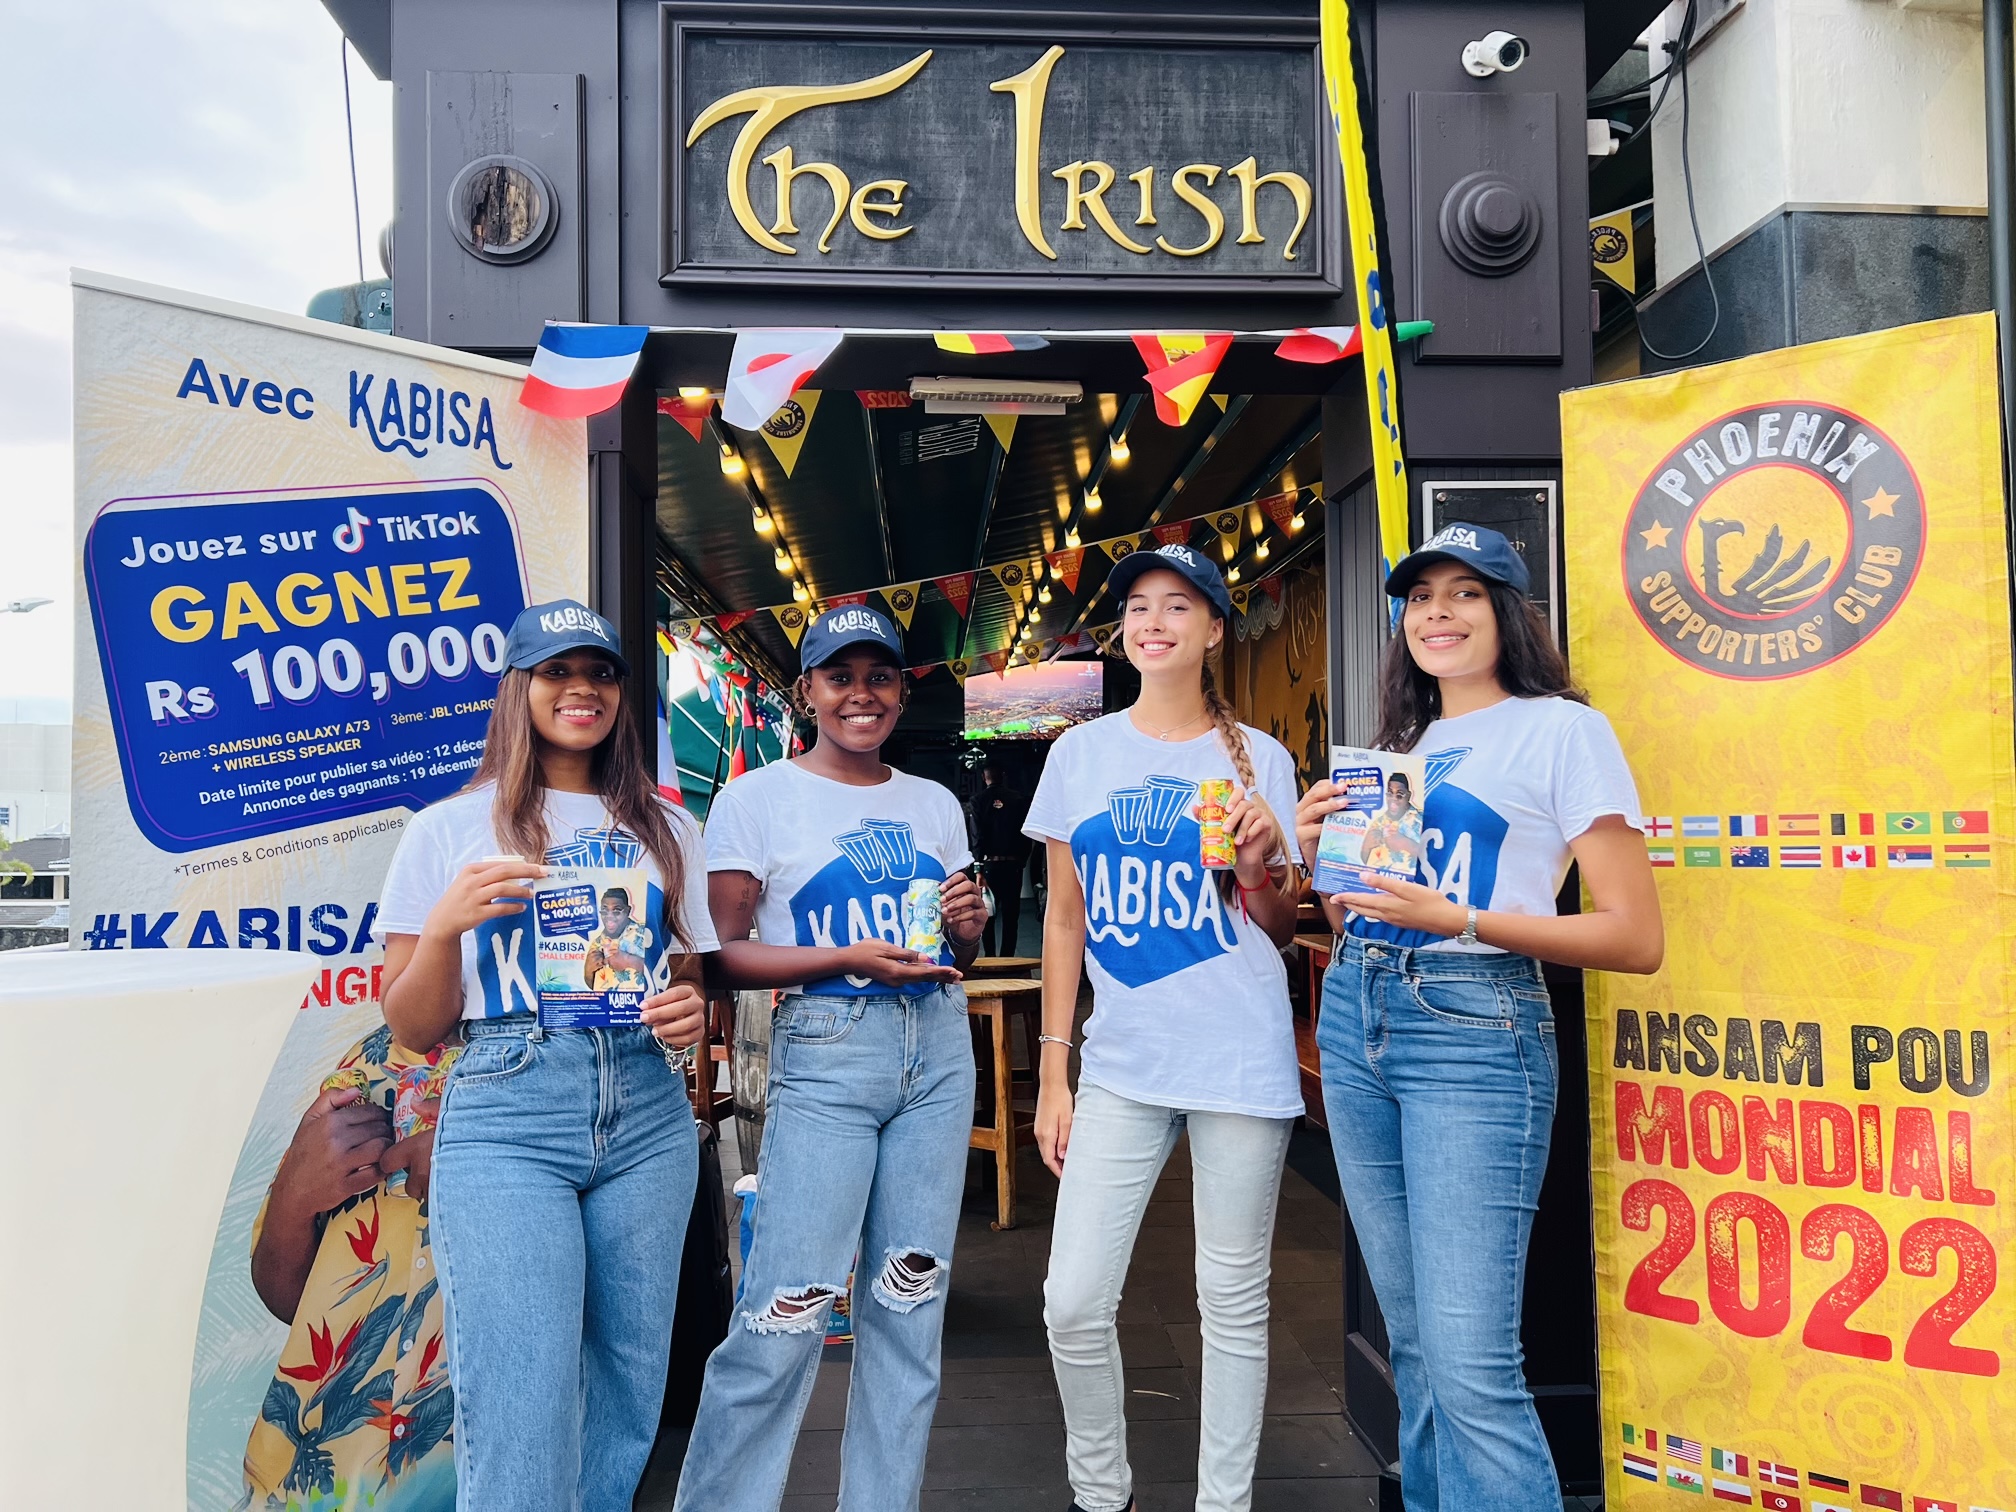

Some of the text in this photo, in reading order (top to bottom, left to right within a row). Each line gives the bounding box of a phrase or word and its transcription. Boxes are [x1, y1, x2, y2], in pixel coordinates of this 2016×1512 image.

[176, 358, 512, 470] Avec KABISA
[1655, 412, 1880, 507] PHOENIX
[121, 510, 480, 568] Jouez sur TikTok
[150, 557, 480, 643] GAGNEZ
[1640, 545, 1902, 665] SUPPORTERS' CLUB
[540, 607, 609, 642] KABISA
[828, 610, 886, 639] KABISA
[145, 622, 506, 724] Rs 100,000
[429, 707, 452, 719] JBL
[208, 734, 282, 757] SAMSUNG
[286, 724, 341, 743] GALAXY
[345, 719, 371, 734] A73
[211, 738, 361, 773] + WIRELESS SPEAKER
[199, 787, 236, 805] Date
[238, 777, 281, 797] limite
[283, 772, 316, 791] pour
[319, 763, 368, 782] publier
[371, 759, 387, 771] sa
[389, 750, 424, 765] vidéo
[434, 745, 451, 757] 12
[242, 794, 306, 816] Annonce
[309, 787, 335, 801] des
[338, 773, 400, 799] gagnants
[410, 767, 426, 780] 19
[1338, 776, 1378, 787] GAGNEZ
[1346, 786, 1381, 796] 100,000
[1326, 824, 1367, 837] CHALLENGE
[1327, 813, 1367, 828] #KABISA
[242, 851, 253, 863] &
[255, 837, 329, 860] Conditions
[332, 818, 404, 844] applicables
[558, 871, 579, 881] KABISA
[541, 895, 589, 910] GAGNEZ
[541, 905, 594, 921] Rs 100,000
[81, 902, 386, 957] #KABISA
[538, 941, 585, 952] #KABISA
[538, 953, 586, 961] CHALLENGE
[608, 992, 641, 1008] KABISA
[1613, 1009, 1990, 1098] ANSAM POU
[1614, 1080, 1996, 1207] MONDIAL
[1620, 1178, 2000, 1378] 2022
